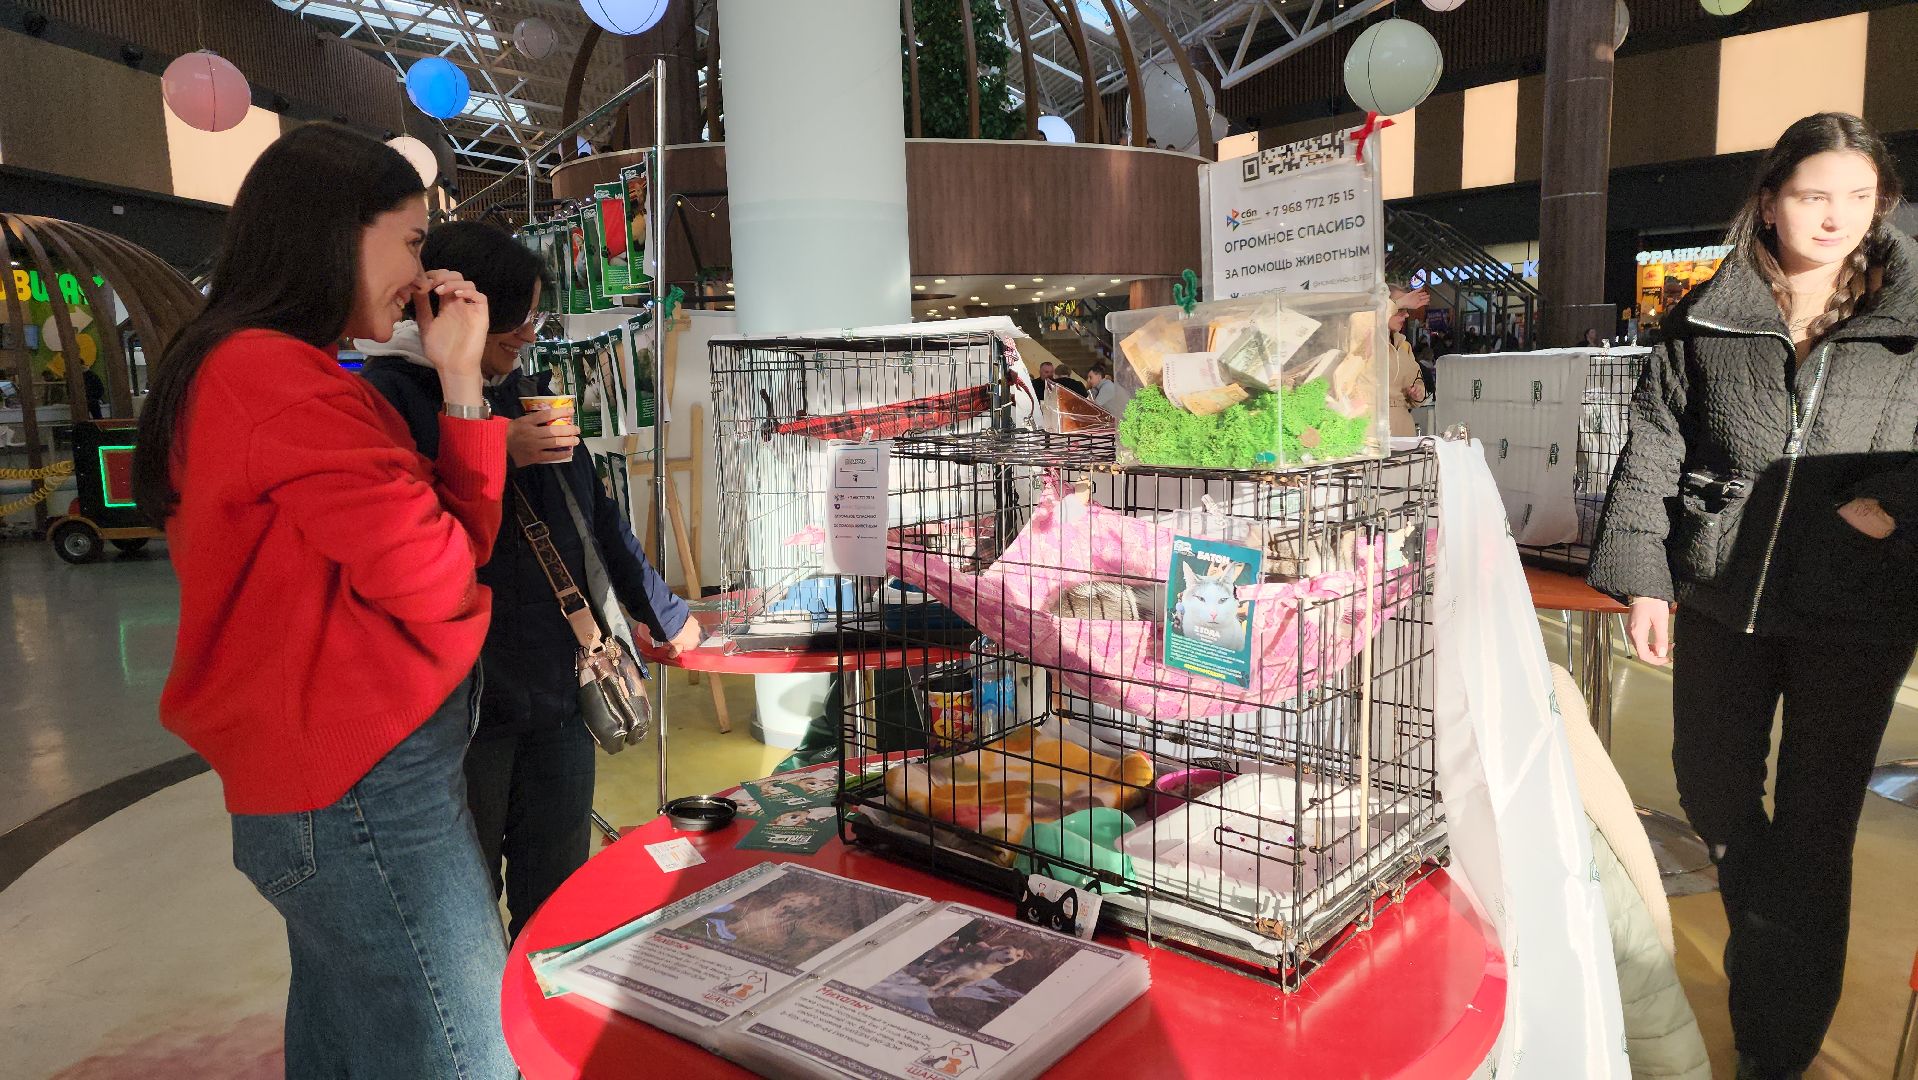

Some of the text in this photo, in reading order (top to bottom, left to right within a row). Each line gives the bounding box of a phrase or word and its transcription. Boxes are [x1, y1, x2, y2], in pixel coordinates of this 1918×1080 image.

[1282, 201, 1303, 215] 968
[1305, 196, 1325, 209] 772
[1327, 192, 1341, 205] 75
[1343, 189, 1355, 201] 15
[1224, 214, 1366, 254] ОГРОМНОЕ СПАСИБО
[1225, 245, 1370, 280] ЗА ПОМОЩЬ ЖИВОТНЫМ
[1197, 550, 1231, 564] БАТОН
